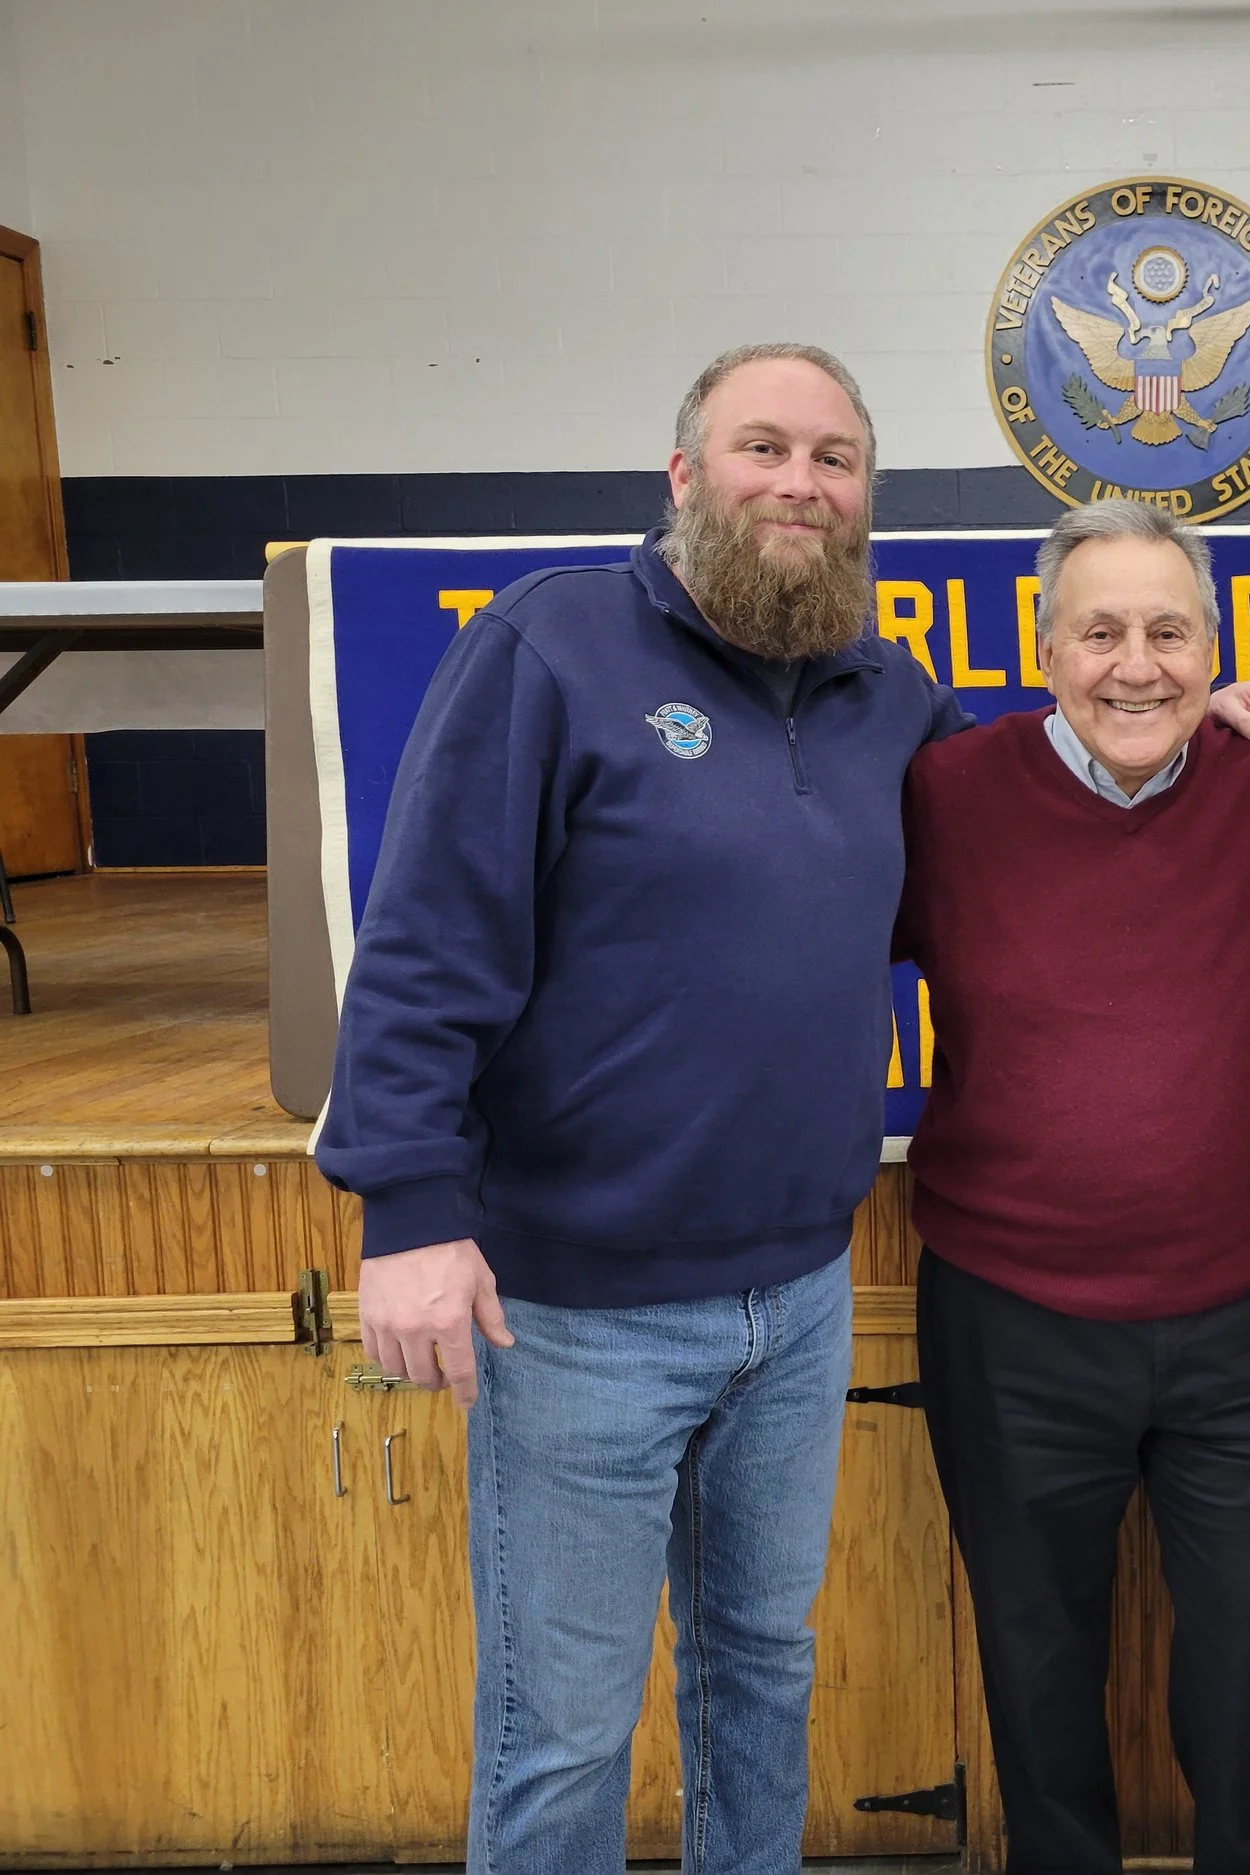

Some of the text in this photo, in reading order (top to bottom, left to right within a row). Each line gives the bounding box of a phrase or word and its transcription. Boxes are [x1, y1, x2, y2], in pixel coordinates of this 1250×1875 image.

[996, 201, 1096, 331] VETERANS
[1111, 186, 1153, 217] OF
[1001, 386, 1036, 425] OF
[1030, 435, 1079, 488] THE
